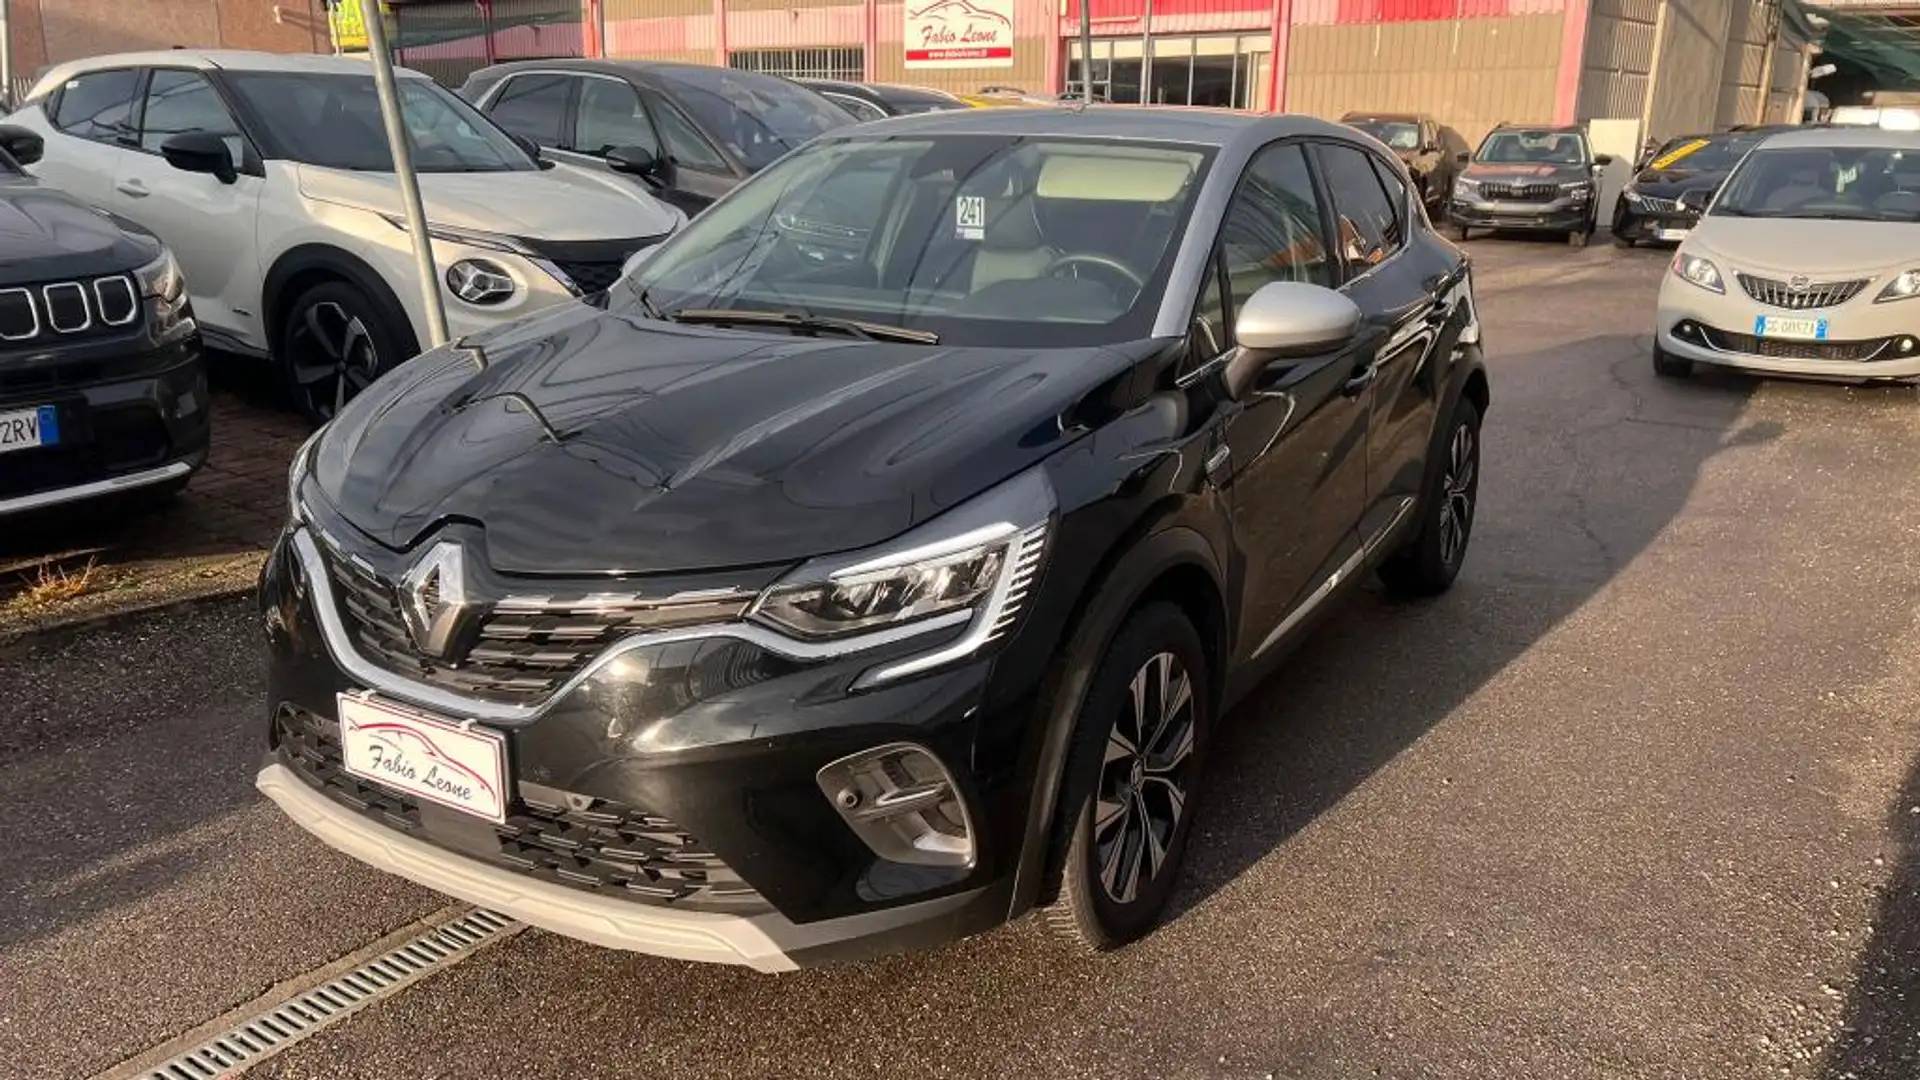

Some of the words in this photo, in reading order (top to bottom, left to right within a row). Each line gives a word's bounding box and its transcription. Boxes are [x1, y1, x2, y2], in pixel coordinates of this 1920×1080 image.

[921, 25, 956, 47] Fabio
[960, 23, 998, 45] Leone
[960, 197, 982, 226] 241
[368, 744, 417, 780] Fabio
[421, 765, 473, 801] Leone
